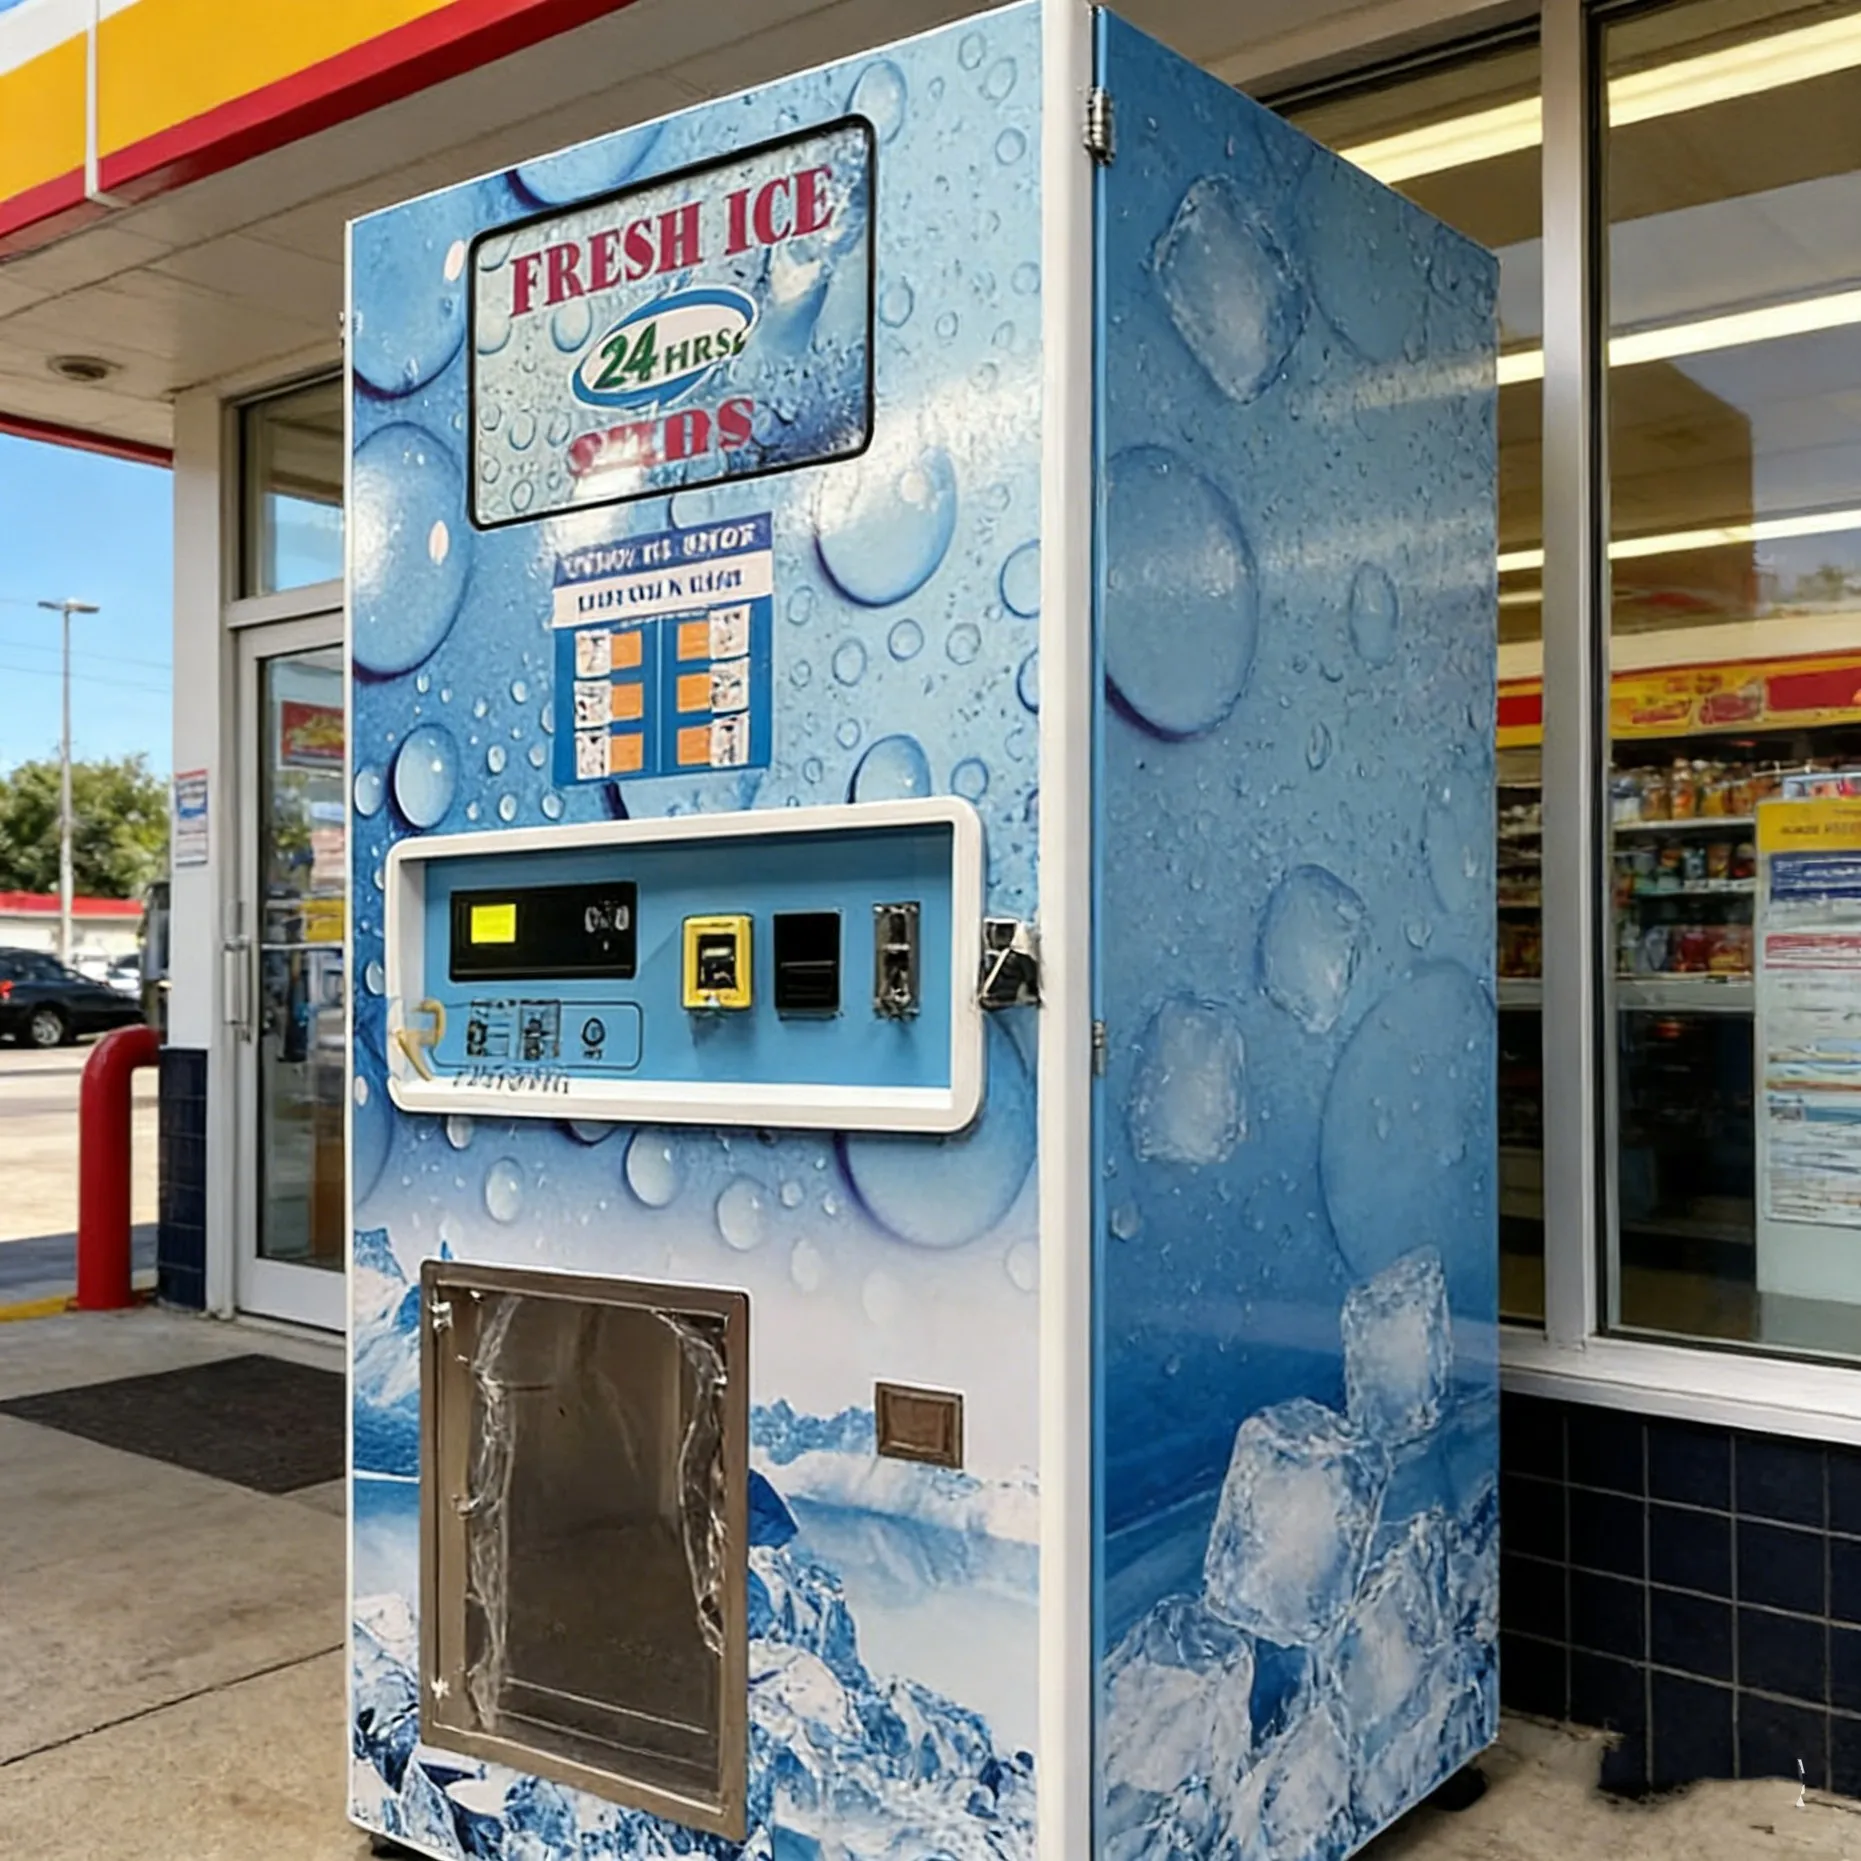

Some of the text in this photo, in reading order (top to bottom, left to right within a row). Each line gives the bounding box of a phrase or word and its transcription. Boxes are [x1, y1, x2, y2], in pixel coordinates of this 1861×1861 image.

[509, 165, 833, 318] FRESH ICE
[592, 321, 659, 389] 24
